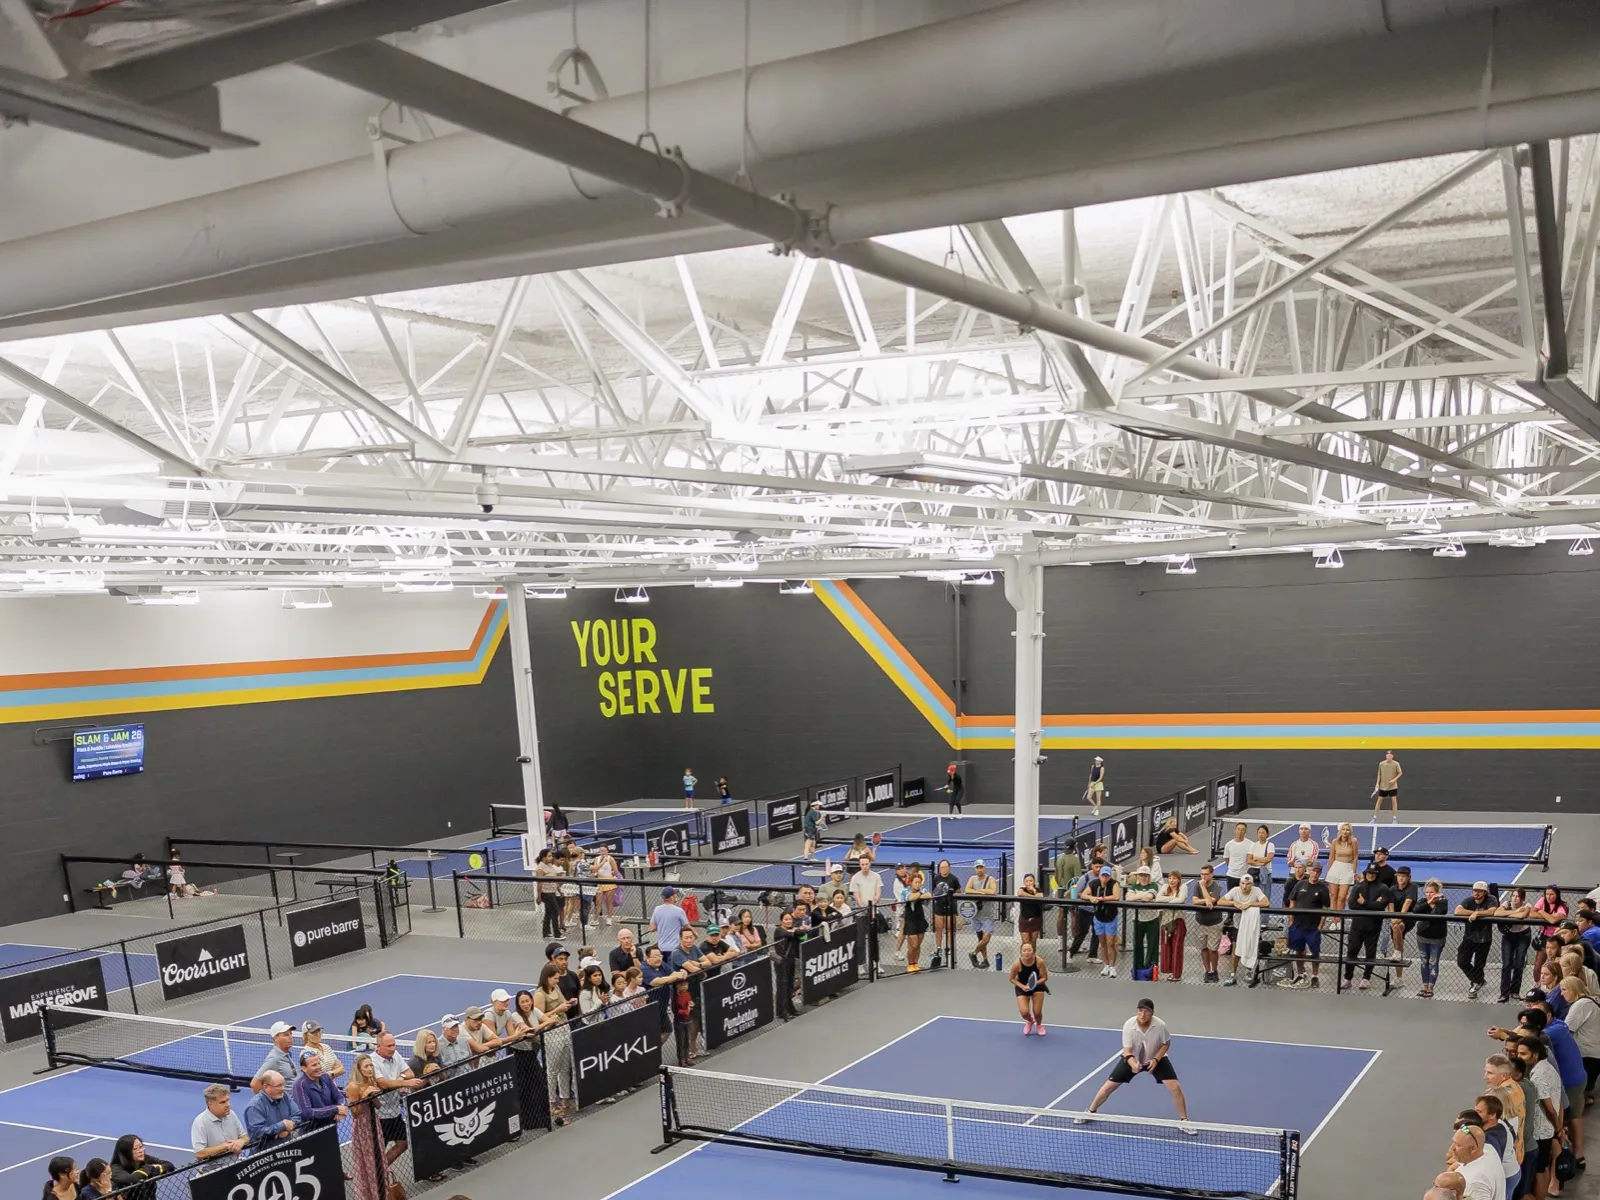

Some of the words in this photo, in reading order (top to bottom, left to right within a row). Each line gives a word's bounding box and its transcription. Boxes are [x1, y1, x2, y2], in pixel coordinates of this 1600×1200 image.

[571, 619, 657, 667] YOUR
[599, 668, 714, 718] SERVE
[76, 735, 101, 745] SLAM
[111, 731, 130, 742] JAM
[131, 730, 142, 739] 26
[874, 782, 894, 802] JOOLA
[909, 788, 923, 797] JOOLA
[306, 928, 332, 944] pure
[331, 921, 358, 935] barre
[162, 962, 208, 986] Coors
[208, 953, 247, 975] LIGHT
[805, 941, 855, 977] SURLY
[813, 965, 841, 985] BREWING
[30, 984, 76, 1001] EXPERIENCE
[54, 985, 98, 1007] GROVE
[722, 985, 758, 1008] PLASCH
[579, 1035, 658, 1079] PIKKL
[409, 1091, 465, 1128] Sālus
[465, 1072, 513, 1097] FINANCIAL
[466, 1081, 515, 1107] ADVISORS
[236, 1155, 275, 1181] FIRESTONE
[275, 1149, 303, 1160] WALKER
[249, 1164, 271, 1178] BREWING
[270, 1158, 292, 1168] COMPANY
